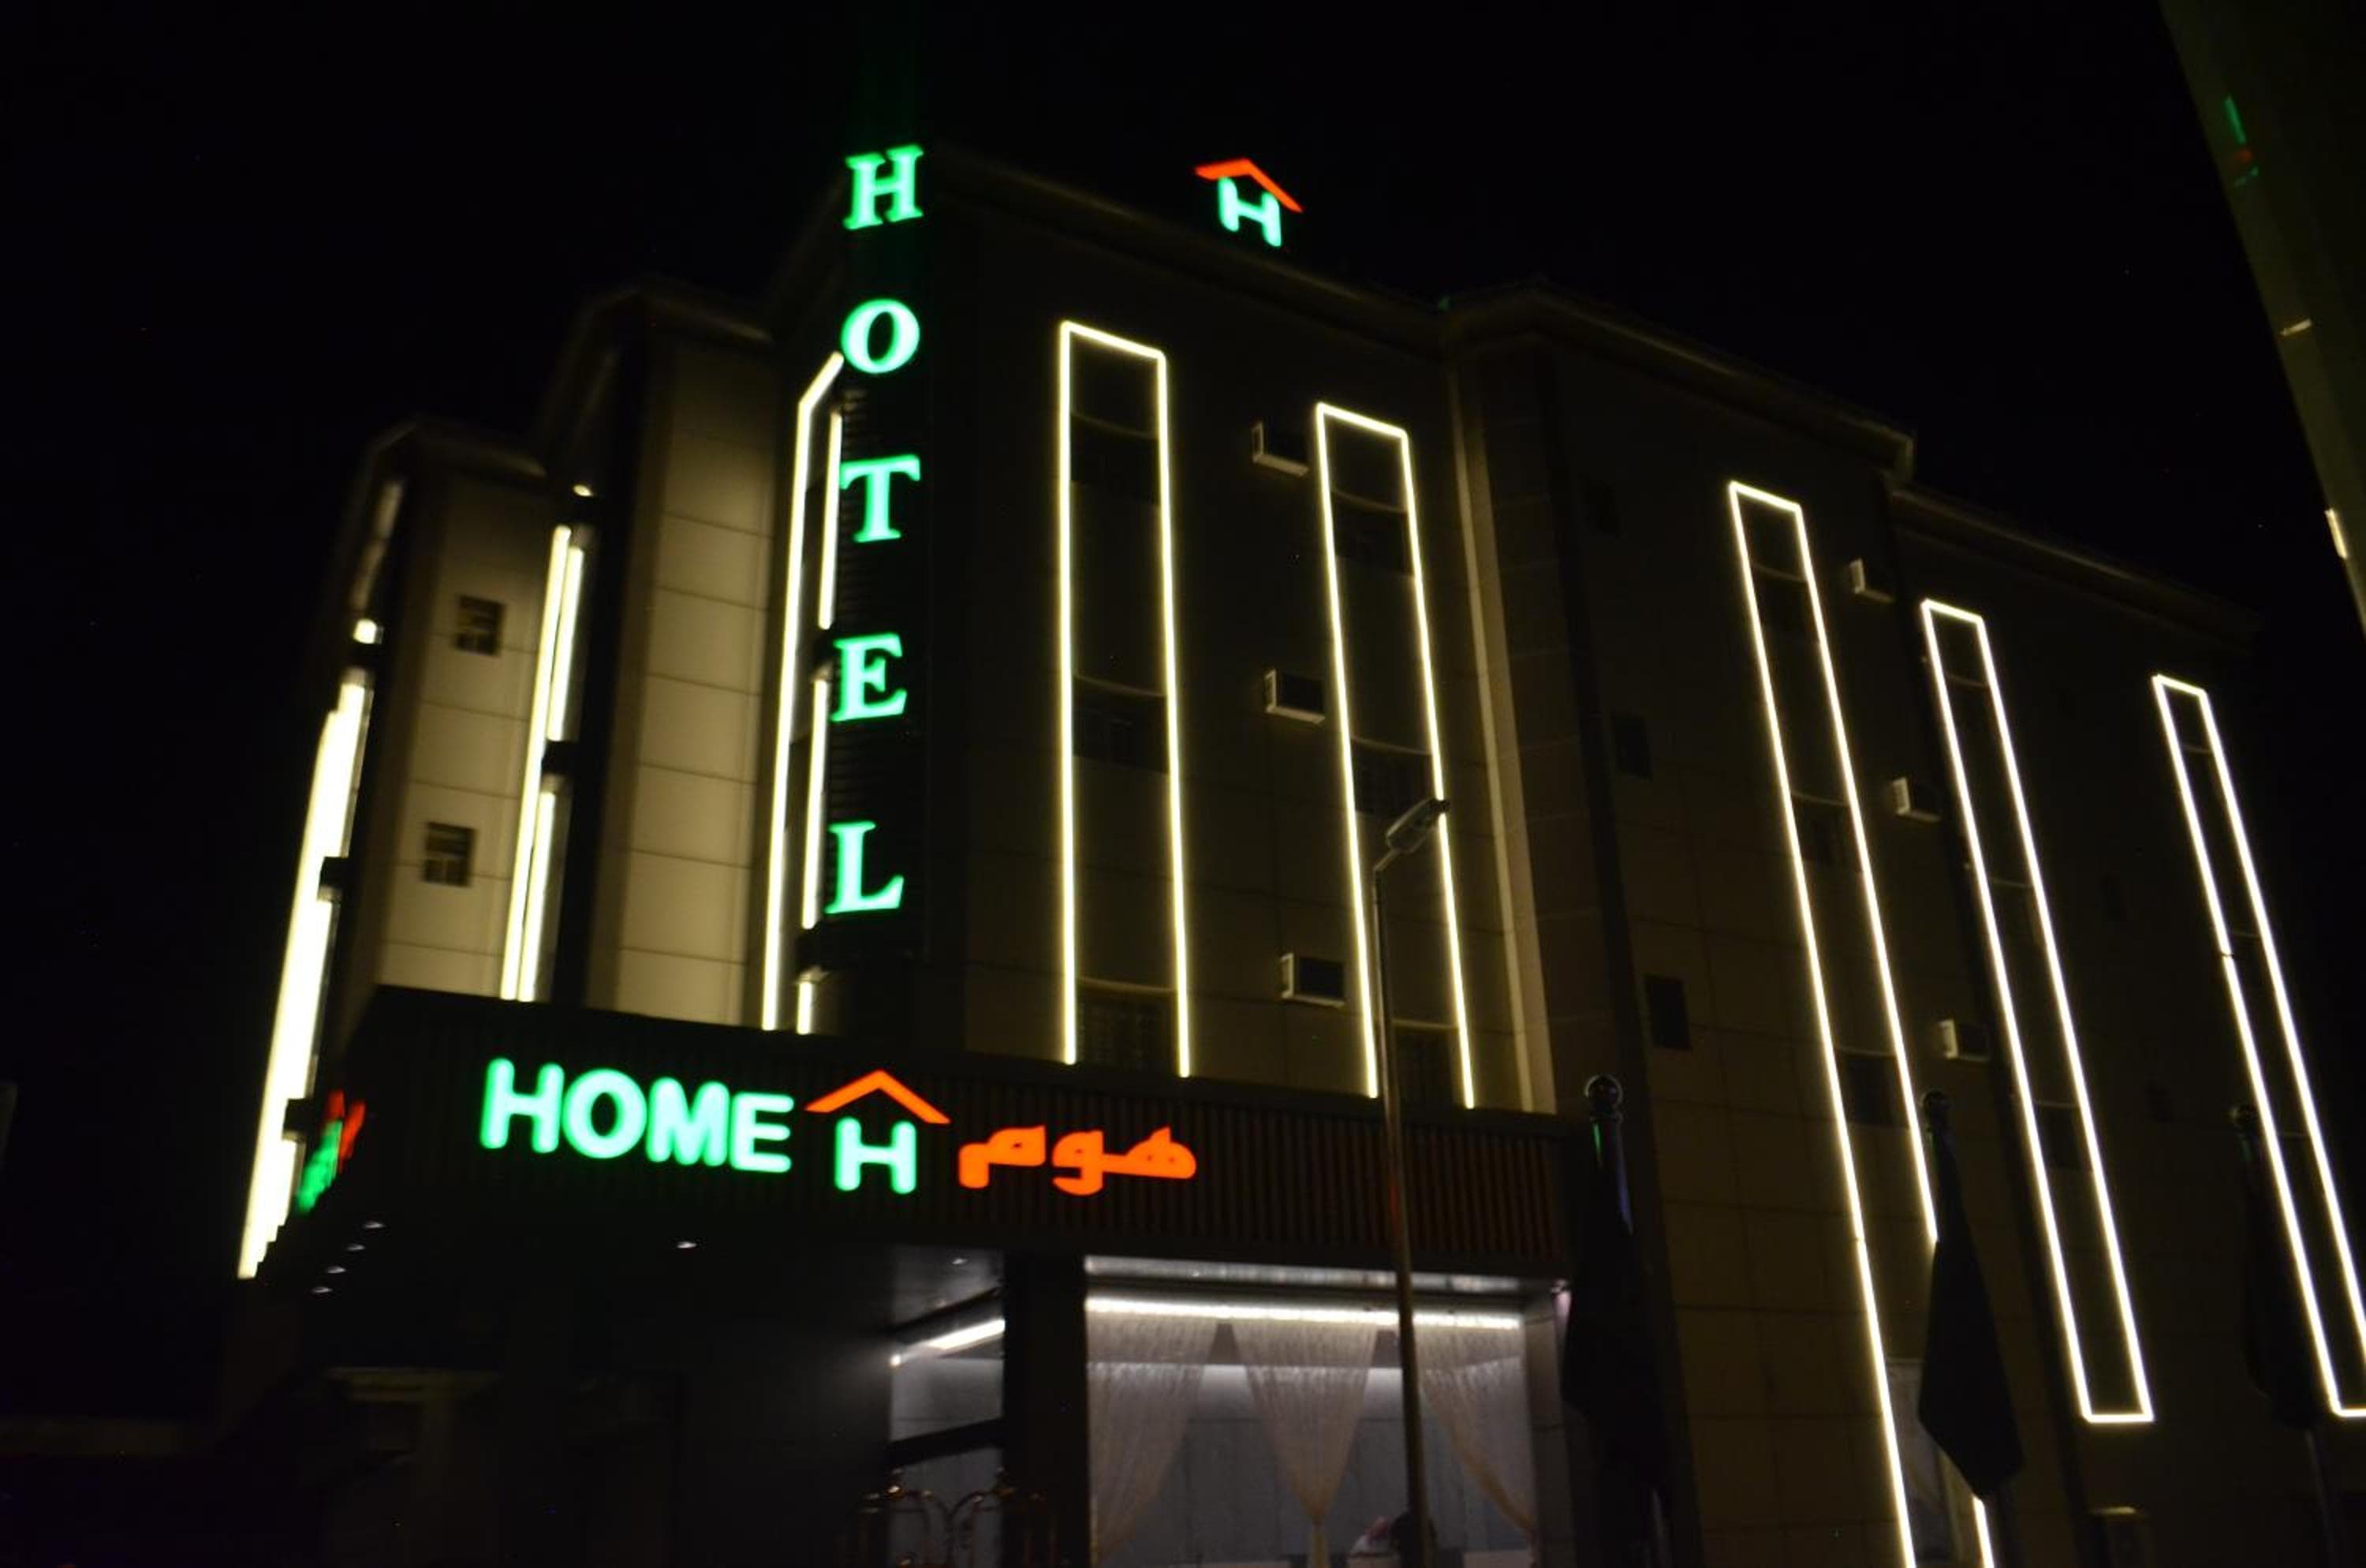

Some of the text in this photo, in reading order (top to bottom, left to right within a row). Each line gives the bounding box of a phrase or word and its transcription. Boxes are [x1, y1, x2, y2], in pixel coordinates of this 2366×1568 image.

[1216, 176, 1283, 248] H
[824, 144, 924, 915] HOTEL
[479, 1057, 795, 1174] HOME
[834, 1116, 917, 1195] H
[958, 1126, 1196, 1196] هوم
